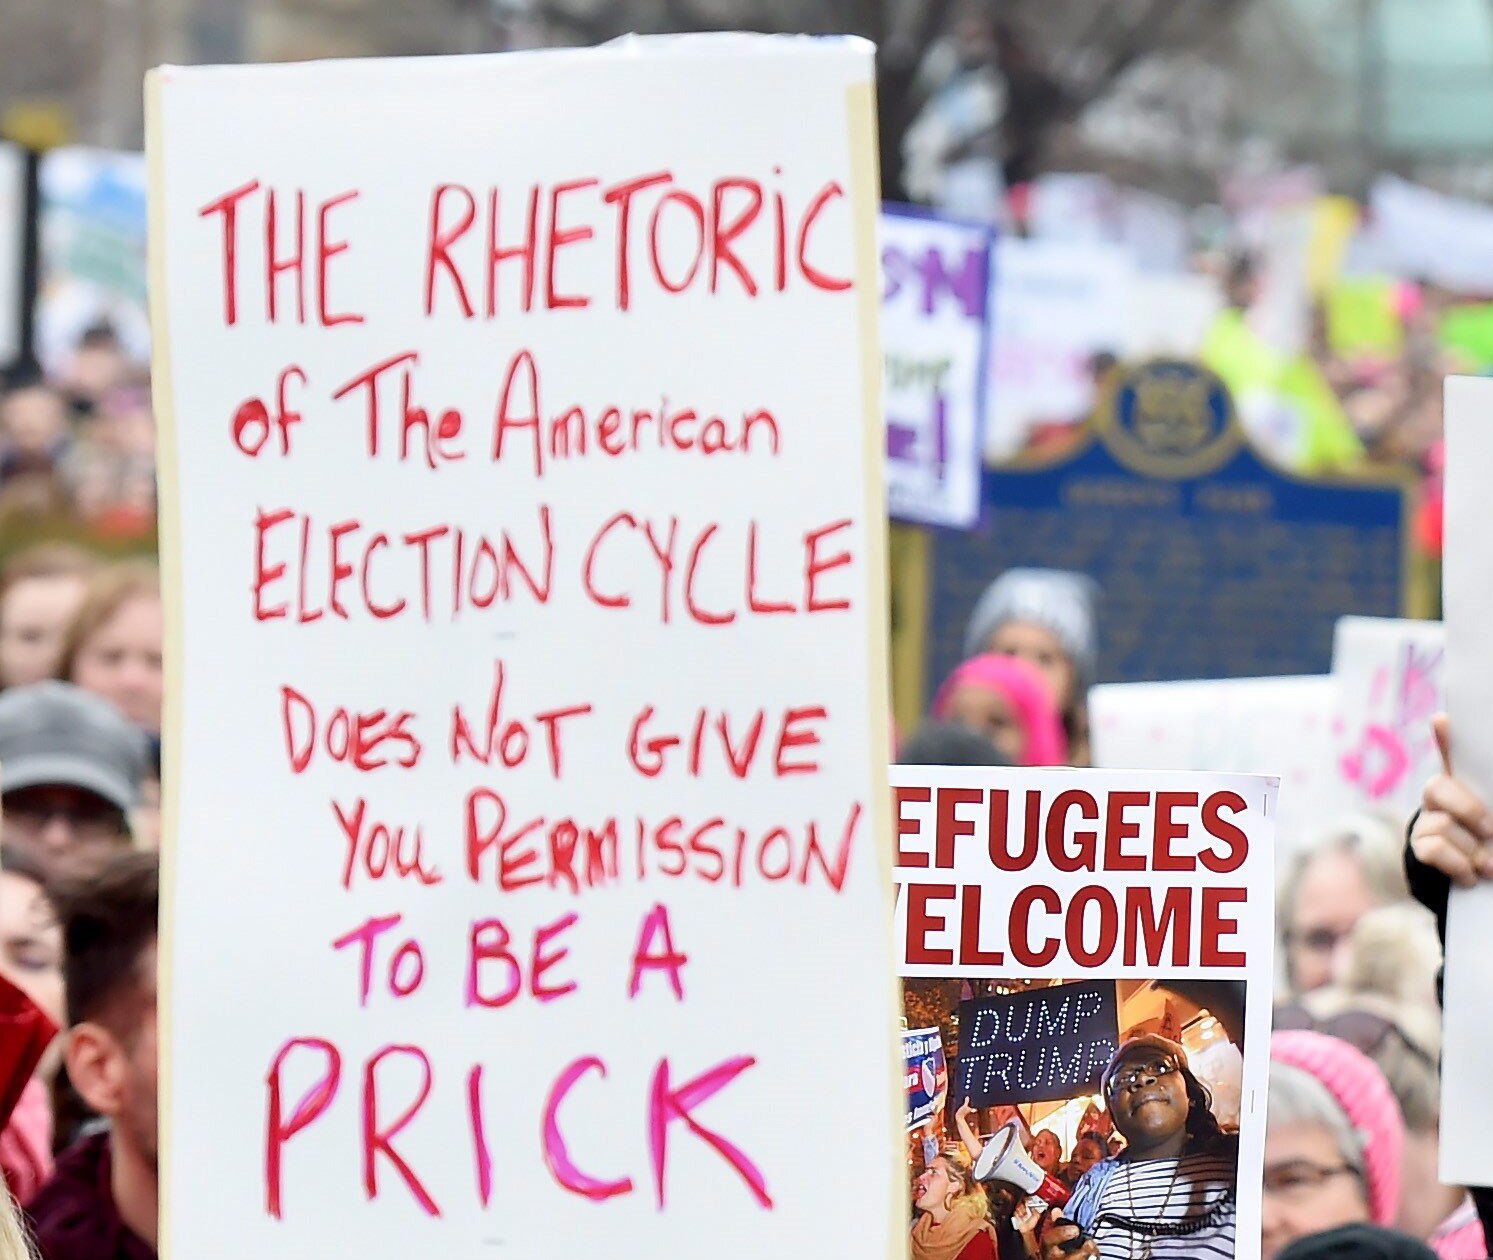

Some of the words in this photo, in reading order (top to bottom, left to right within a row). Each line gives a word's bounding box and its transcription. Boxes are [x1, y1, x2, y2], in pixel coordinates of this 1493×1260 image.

[200, 181, 365, 327] THE
[426, 171, 854, 319] RHETORIC
[231, 366, 308, 457] of
[334, 351, 465, 469] The
[493, 350, 780, 475] American
[253, 506, 553, 624] ELECTION
[584, 512, 853, 626] CYCLE
[283, 684, 421, 773] DOES
[451, 660, 592, 777] NOT
[627, 706, 828, 779] GIVE
[465, 787, 863, 894] PERMISSION
[894, 786, 1250, 874] EFUGEES
[332, 913, 426, 1006] TO
[467, 913, 578, 1008] BE
[629, 903, 688, 1001] A
[894, 883, 1248, 968] ELCOME
[960, 1039, 1116, 1093] TRUMP
[970, 991, 1103, 1048] DUMP
[264, 1036, 774, 1220] PRICK
